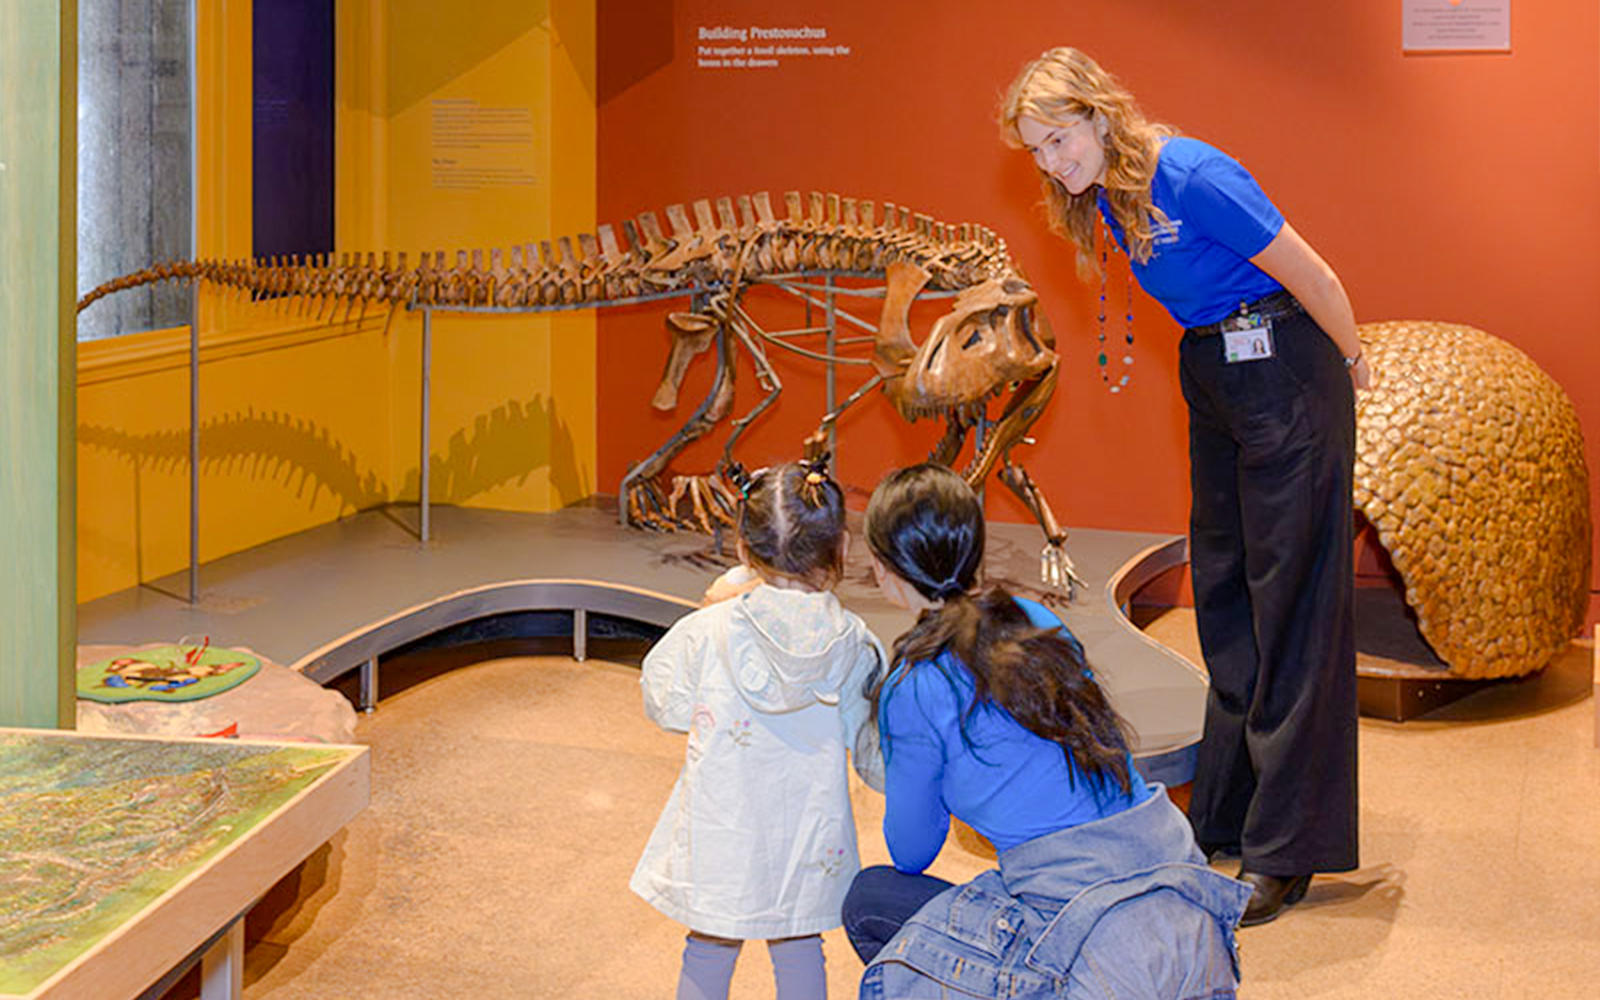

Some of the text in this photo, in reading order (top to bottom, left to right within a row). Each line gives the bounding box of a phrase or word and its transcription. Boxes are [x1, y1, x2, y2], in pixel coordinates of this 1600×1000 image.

[698, 25, 827, 42] Building Prestosuchus
[698, 46, 711, 55] Put
[713, 46, 745, 56] together
[754, 46, 775, 55] fossil
[812, 47, 834, 56] using
[835, 46, 849, 55] the
[698, 58, 721, 67] bones
[722, 58, 731, 67] in
[732, 58, 746, 67] the
